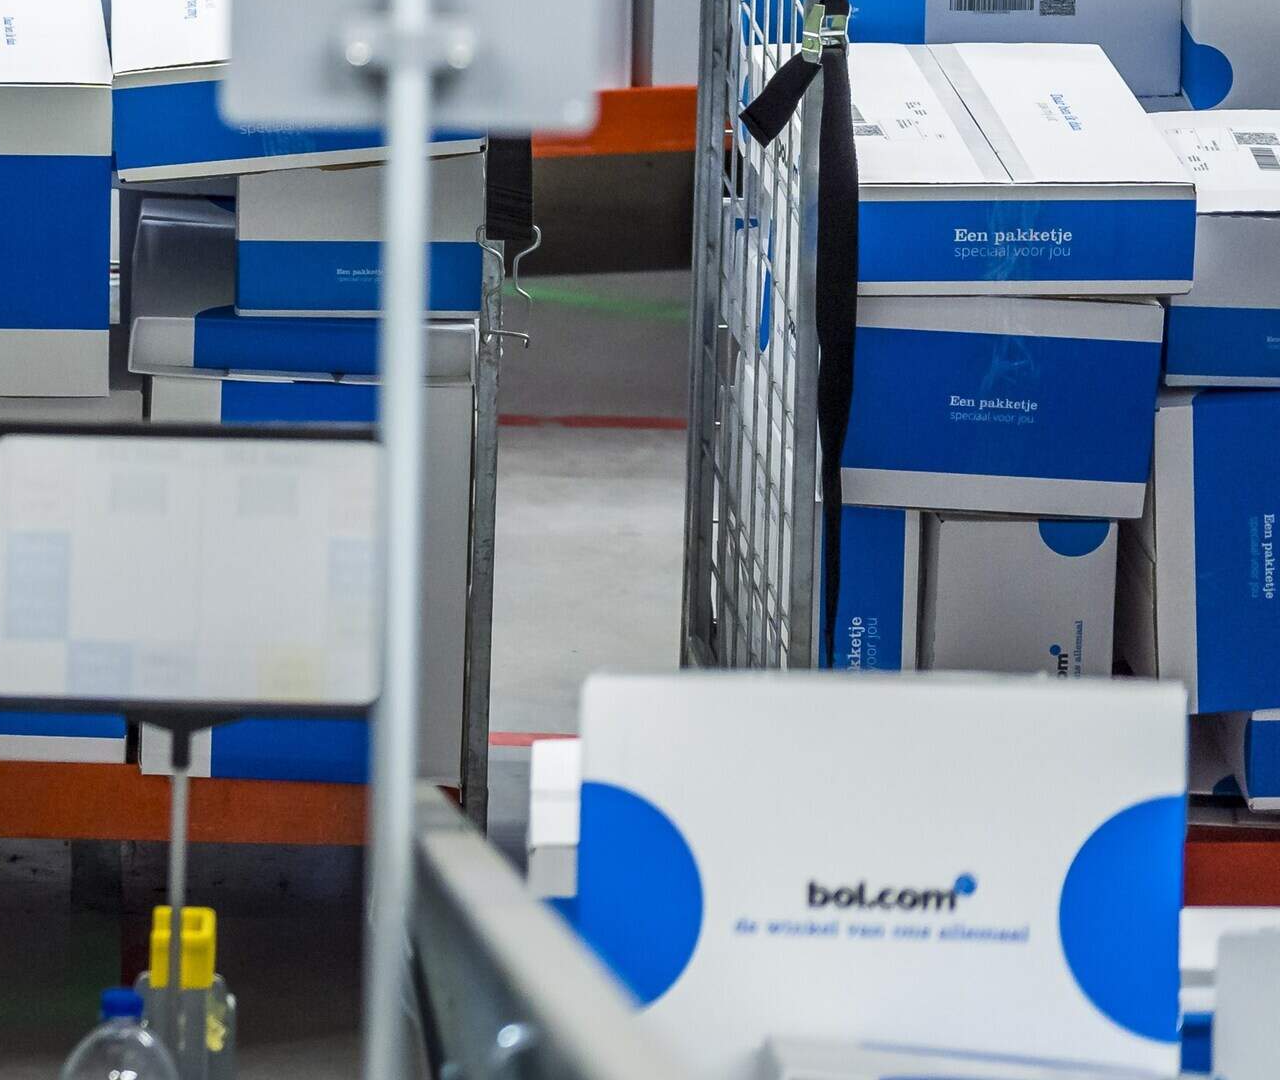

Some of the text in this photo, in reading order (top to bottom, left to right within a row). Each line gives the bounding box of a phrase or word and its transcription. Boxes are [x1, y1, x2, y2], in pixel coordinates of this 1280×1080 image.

[953, 228, 1072, 245] Een pakketje
[954, 246, 1071, 260] speciaal voor jou
[949, 395, 1038, 413] Een pakketje
[950, 411, 1034, 426] speciaal voor jou
[1262, 513, 1277, 599] Een pakketje
[866, 617, 880, 639] jou
[848, 616, 865, 670] kketje
[807, 880, 958, 912] bol.com
